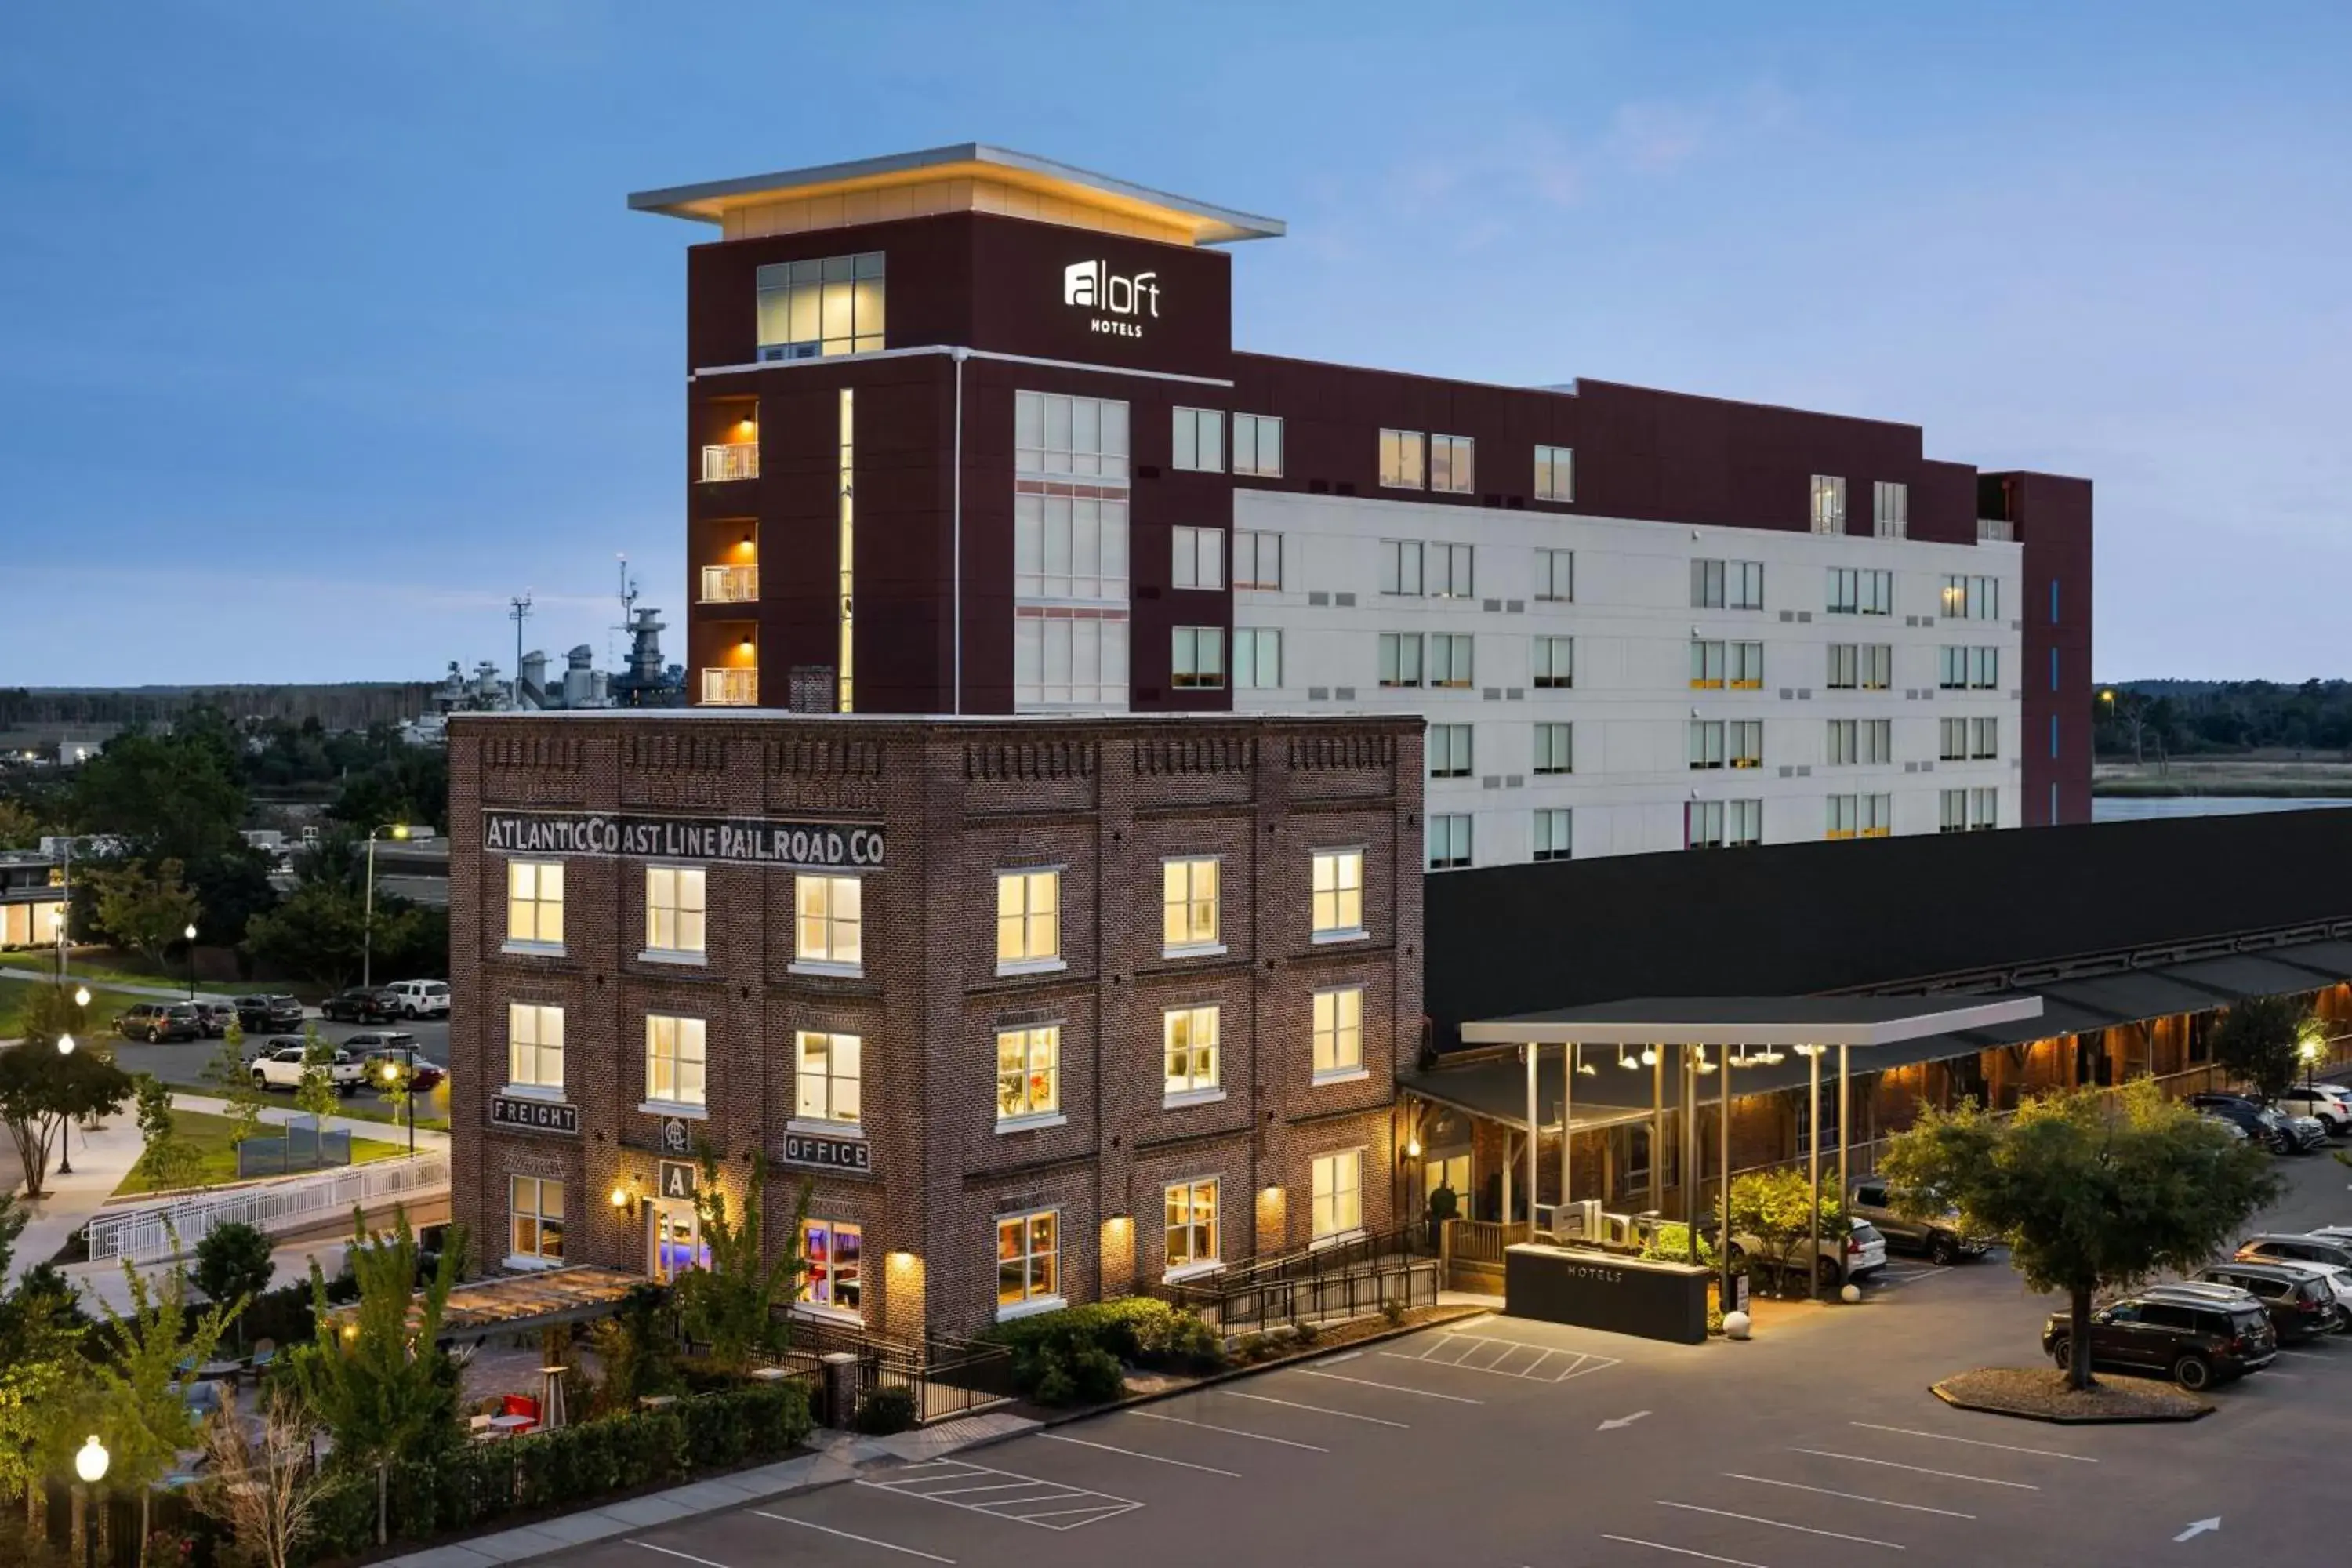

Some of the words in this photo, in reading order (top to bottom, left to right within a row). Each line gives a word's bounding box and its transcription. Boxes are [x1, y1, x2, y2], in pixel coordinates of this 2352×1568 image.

[1065, 260, 1160, 318] aloft
[1091, 318, 1142, 338] HOTELS
[487, 816, 587, 850] ATLANTIC
[587, 818, 661, 853] COAST
[666, 823, 715, 855] LINE
[851, 829, 884, 864] CO
[495, 1101, 573, 1127] FREIGHT
[788, 1138, 866, 1166] OFFICE
[669, 1167, 684, 1196] A
[1568, 1265, 1622, 1283] HOTELS
